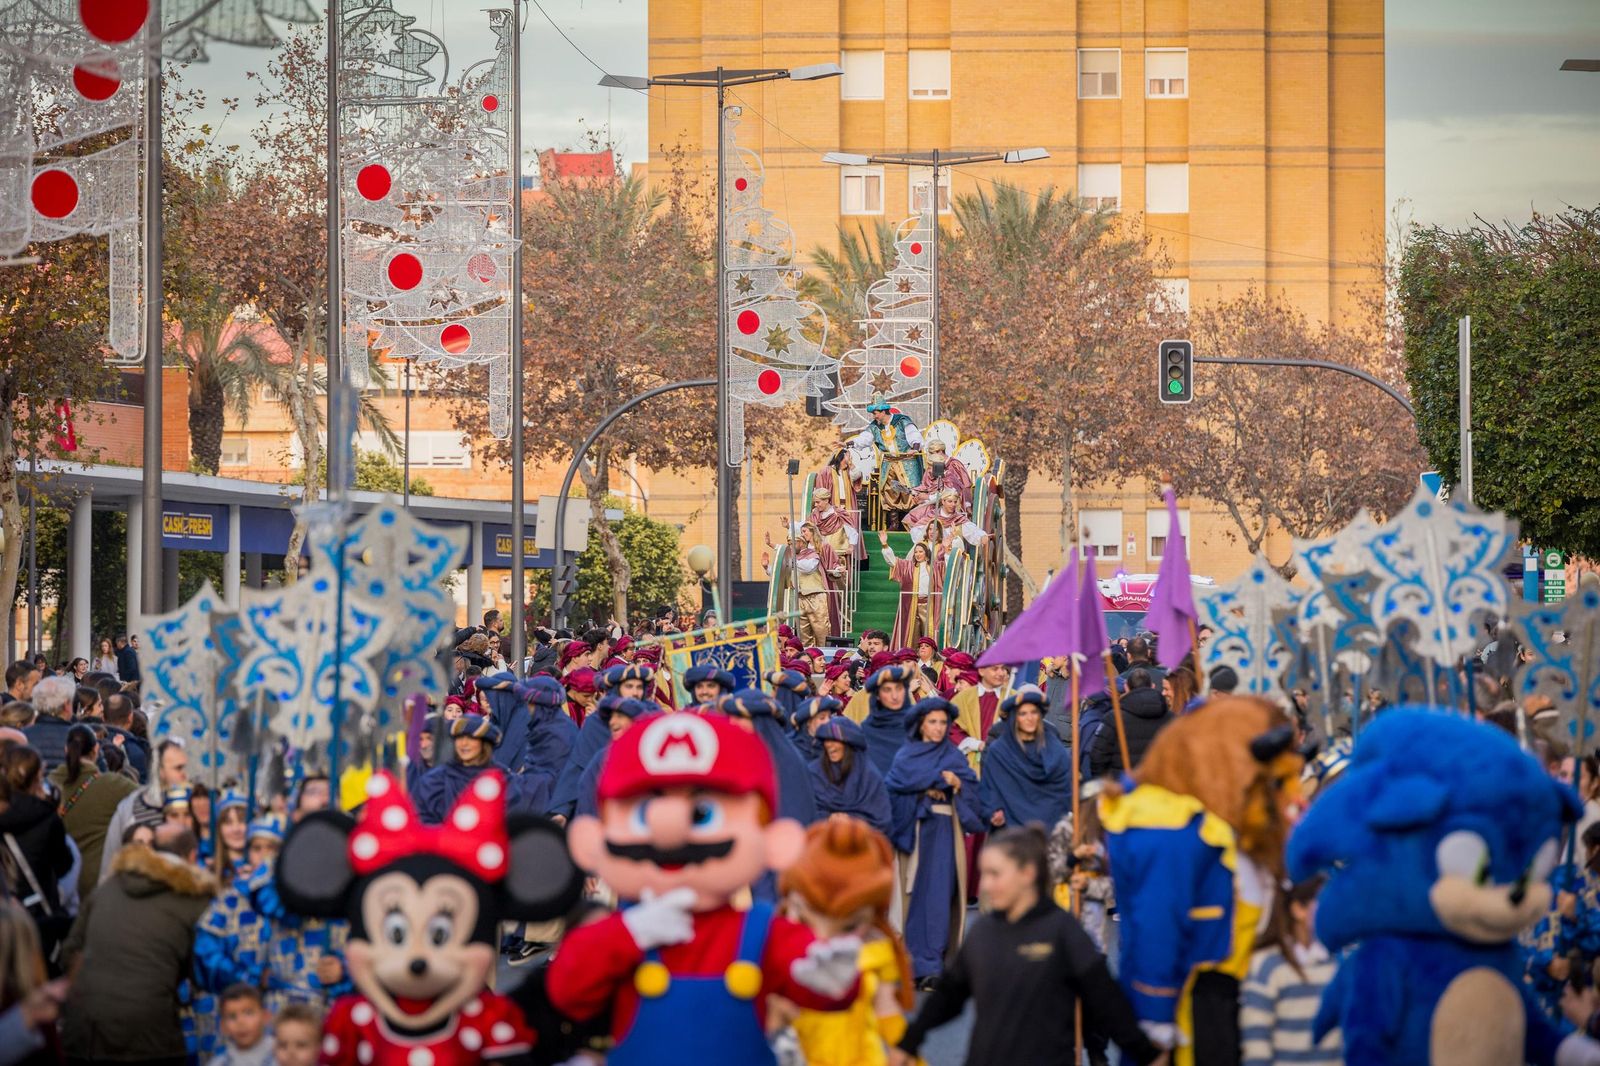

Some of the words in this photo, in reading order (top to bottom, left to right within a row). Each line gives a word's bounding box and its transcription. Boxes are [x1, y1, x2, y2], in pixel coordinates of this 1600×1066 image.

[164, 515, 183, 533] CASH
[188, 517, 211, 536] FRESH
[496, 537, 512, 553] CAS
[658, 732, 698, 758] M
